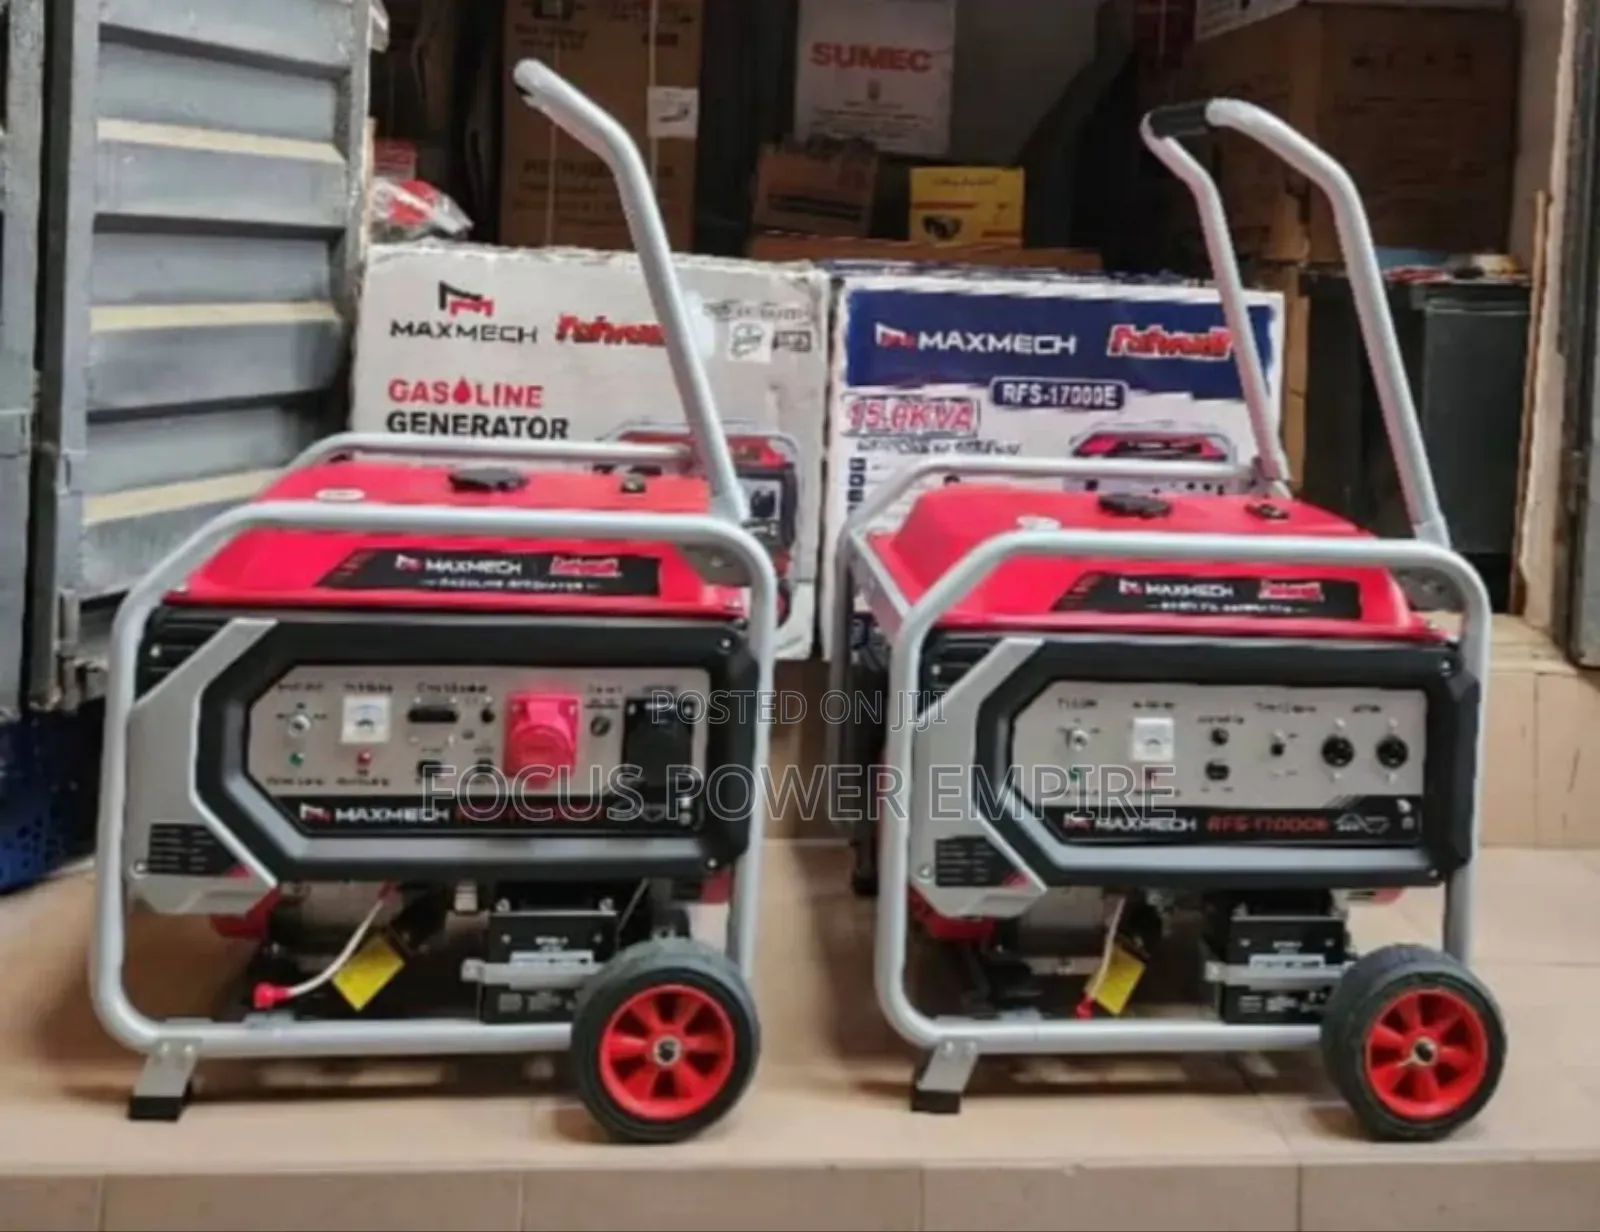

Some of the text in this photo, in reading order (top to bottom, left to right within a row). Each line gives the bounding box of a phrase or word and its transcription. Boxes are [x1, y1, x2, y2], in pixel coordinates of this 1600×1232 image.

[809, 42, 933, 73] SUMEC
[390, 319, 537, 344] MAXMECH
[917, 329, 1077, 355] MAXMECH
[388, 377, 543, 408] GASOLINE
[386, 410, 569, 440] GENERATOR
[425, 557, 522, 576] MAXMECH
